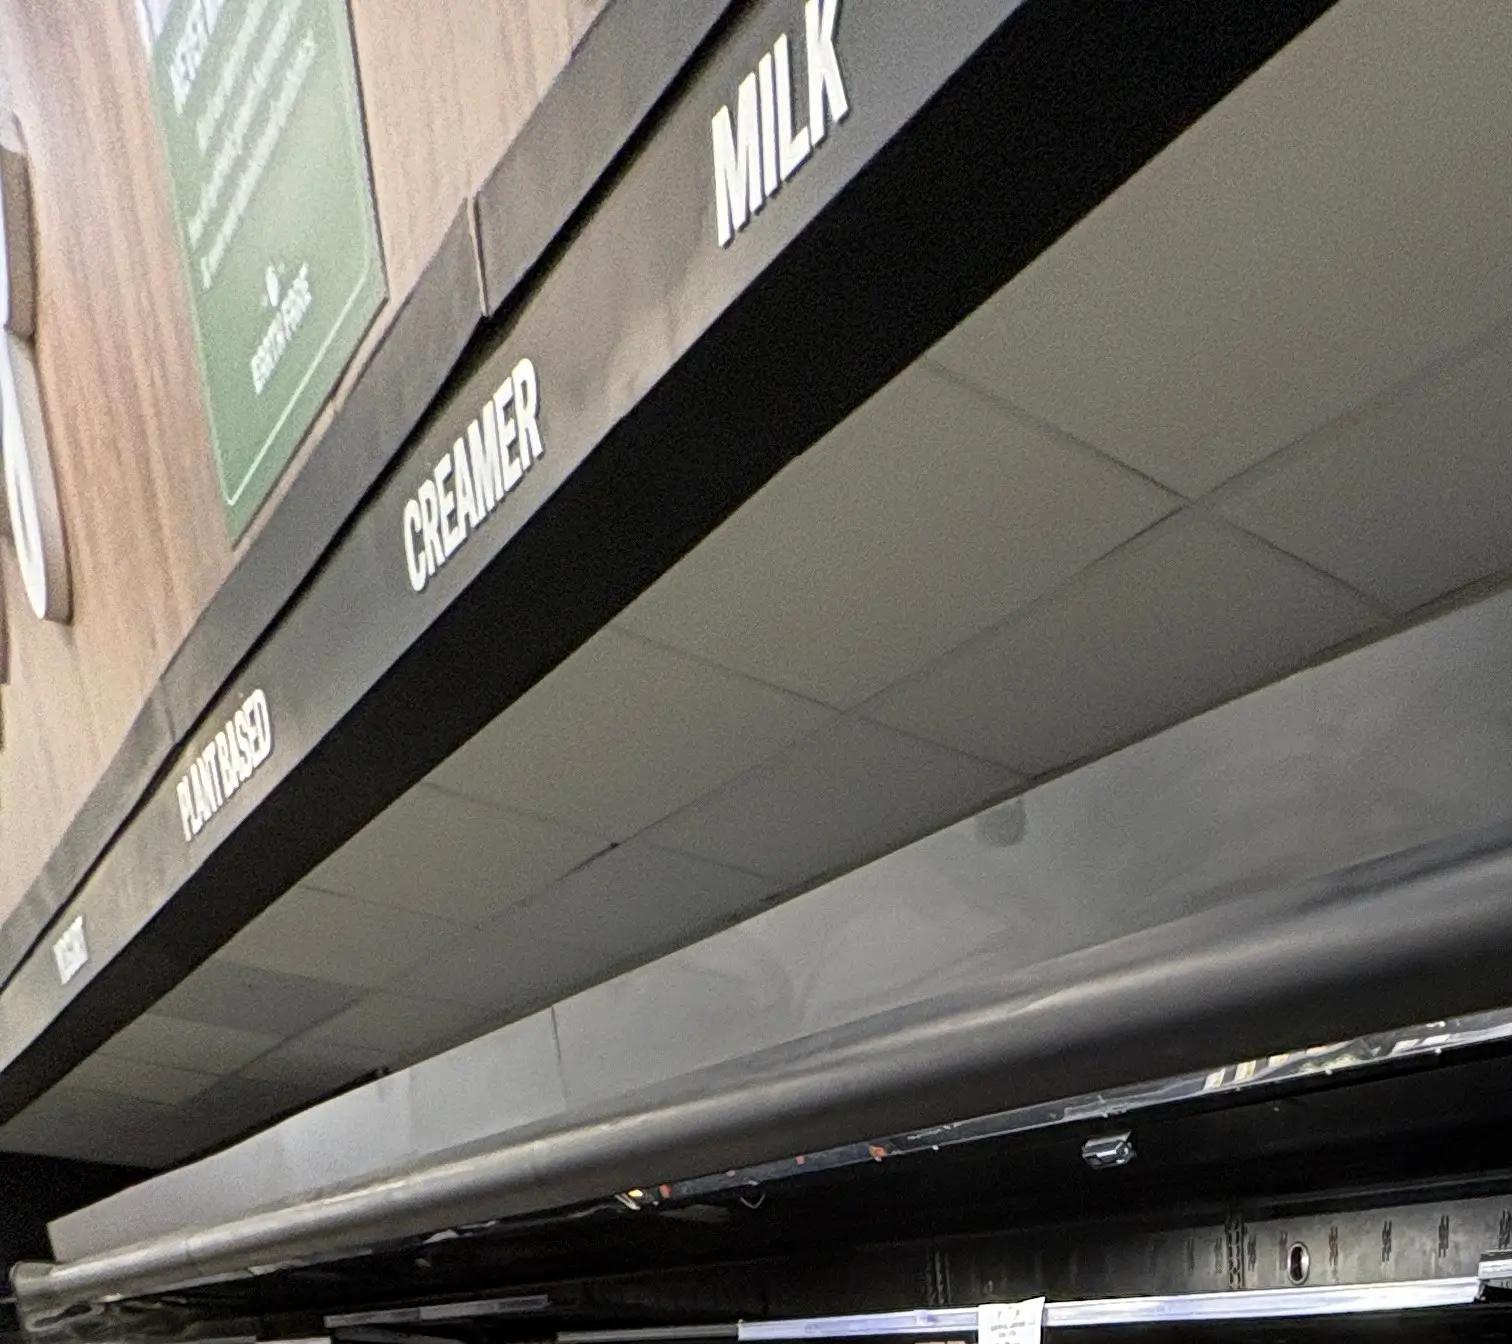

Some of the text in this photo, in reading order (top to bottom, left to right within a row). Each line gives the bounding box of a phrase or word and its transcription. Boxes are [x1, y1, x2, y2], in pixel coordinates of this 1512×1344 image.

[711, 0, 849, 247] MILK
[403, 358, 543, 592] CREAMER
[176, 688, 271, 842] PLANT BASED
